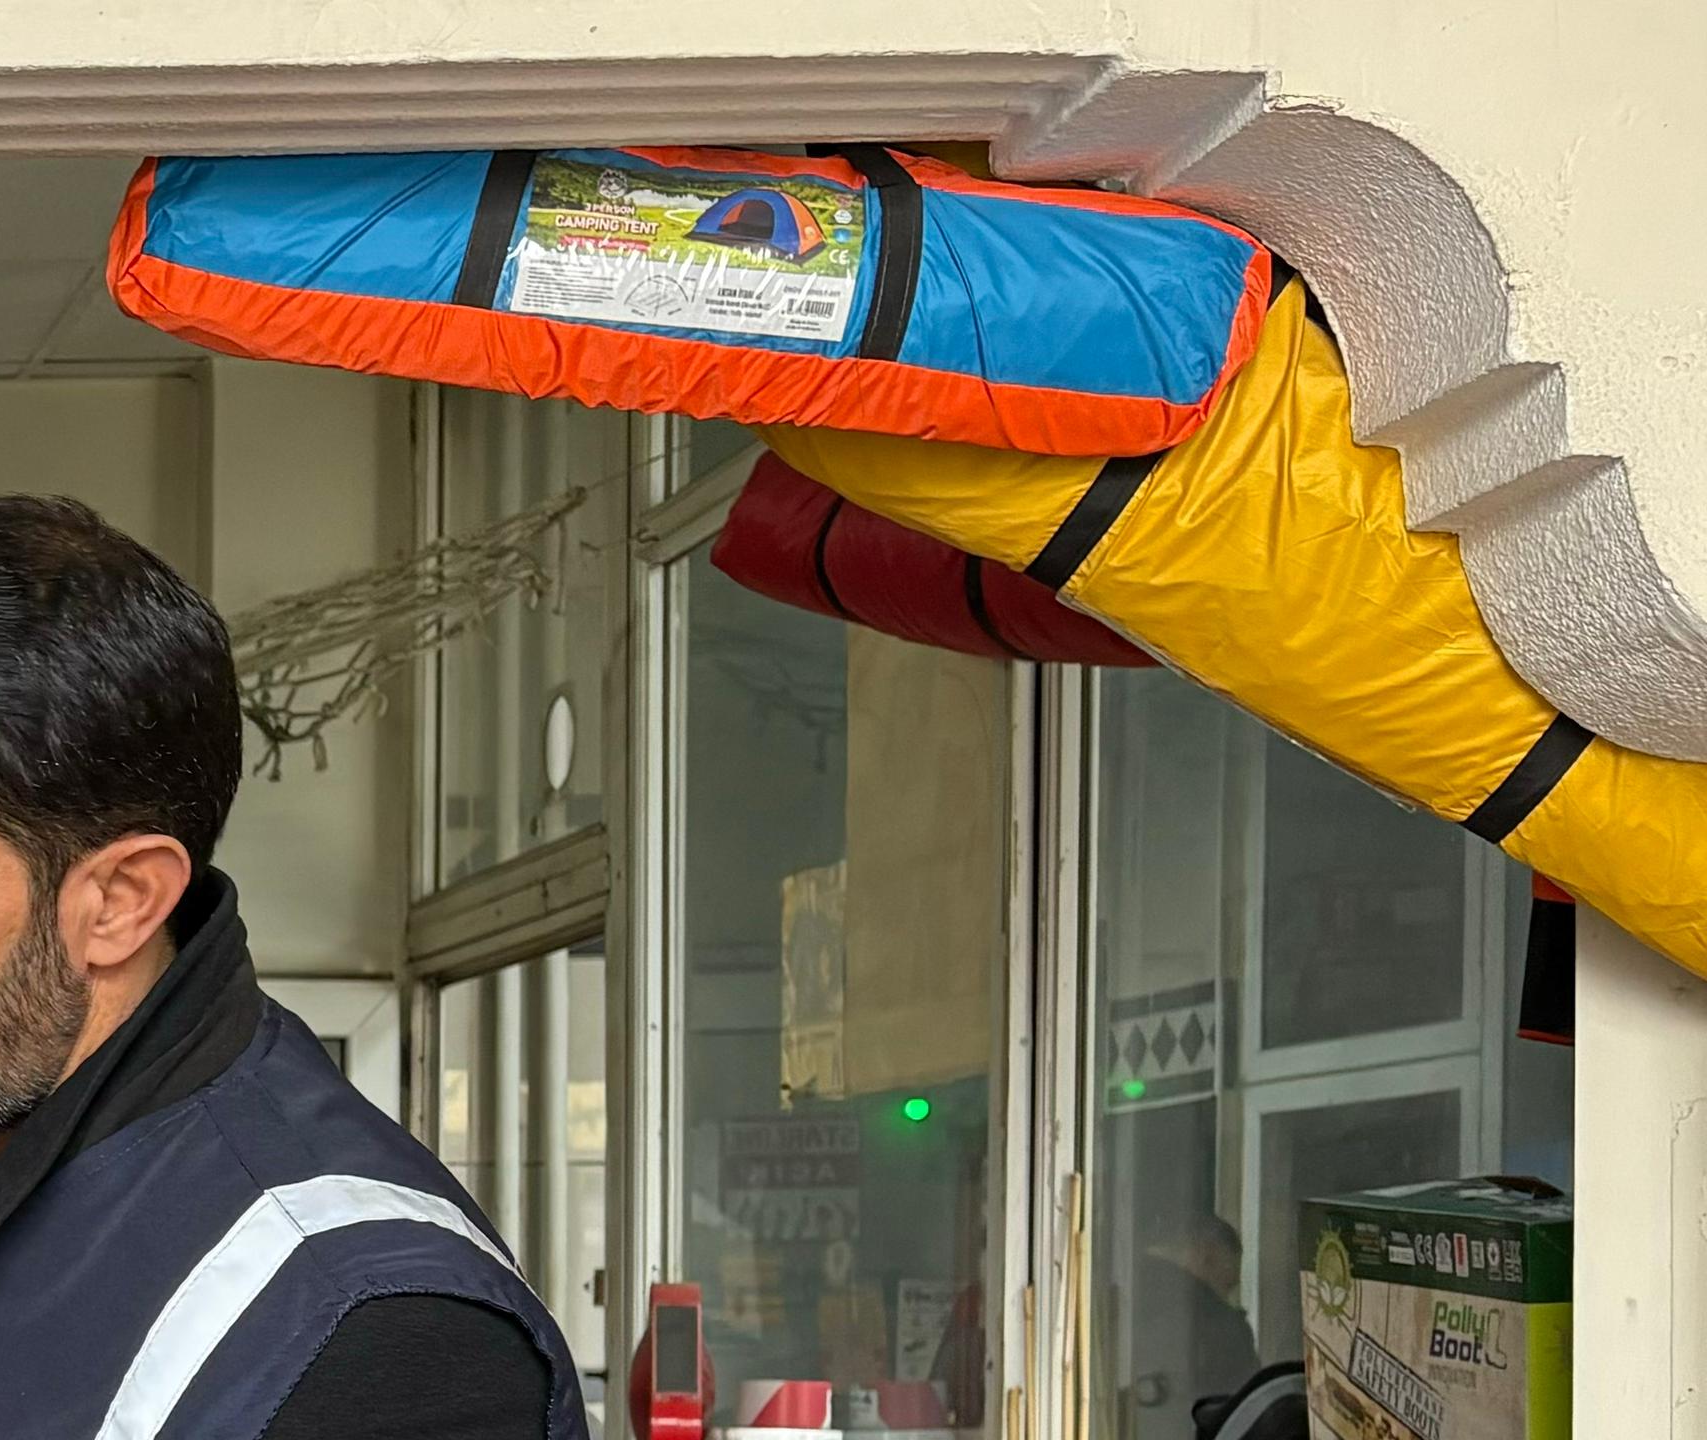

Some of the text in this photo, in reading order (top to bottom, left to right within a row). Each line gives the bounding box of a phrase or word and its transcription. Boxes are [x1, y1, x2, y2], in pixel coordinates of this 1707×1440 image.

[592, 203, 636, 216] PERSON
[554, 214, 660, 235] CAMPING TENT
[1435, 1301, 1486, 1342] Polly
[1429, 1330, 1483, 1364] Boot
